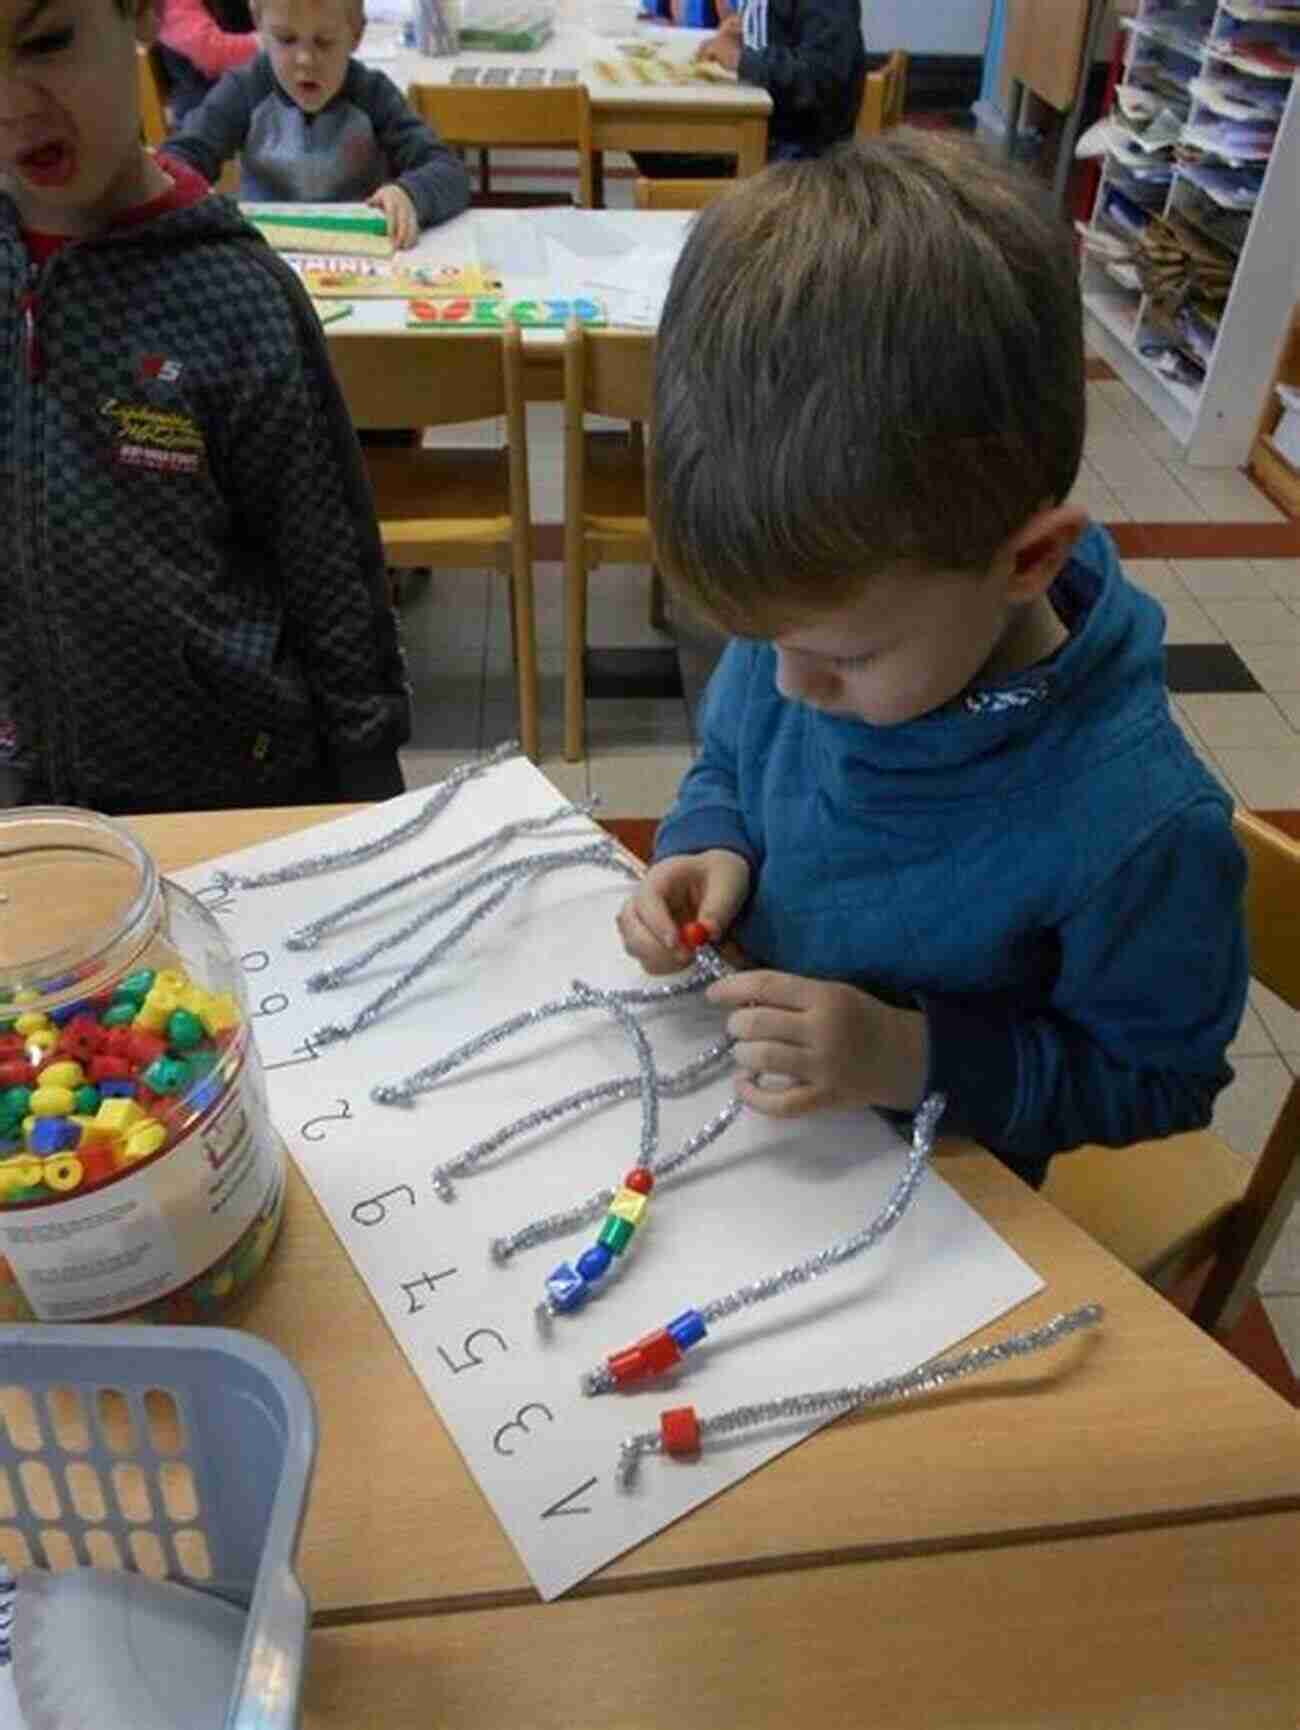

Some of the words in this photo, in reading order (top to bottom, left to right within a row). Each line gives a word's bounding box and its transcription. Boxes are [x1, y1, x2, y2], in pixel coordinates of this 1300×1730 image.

[300, 1098, 353, 1141] 2
[399, 1267, 457, 1314] 7
[436, 1327, 508, 1373] 5
[493, 1402, 553, 1456] 3
[540, 1476, 598, 1519] 1
